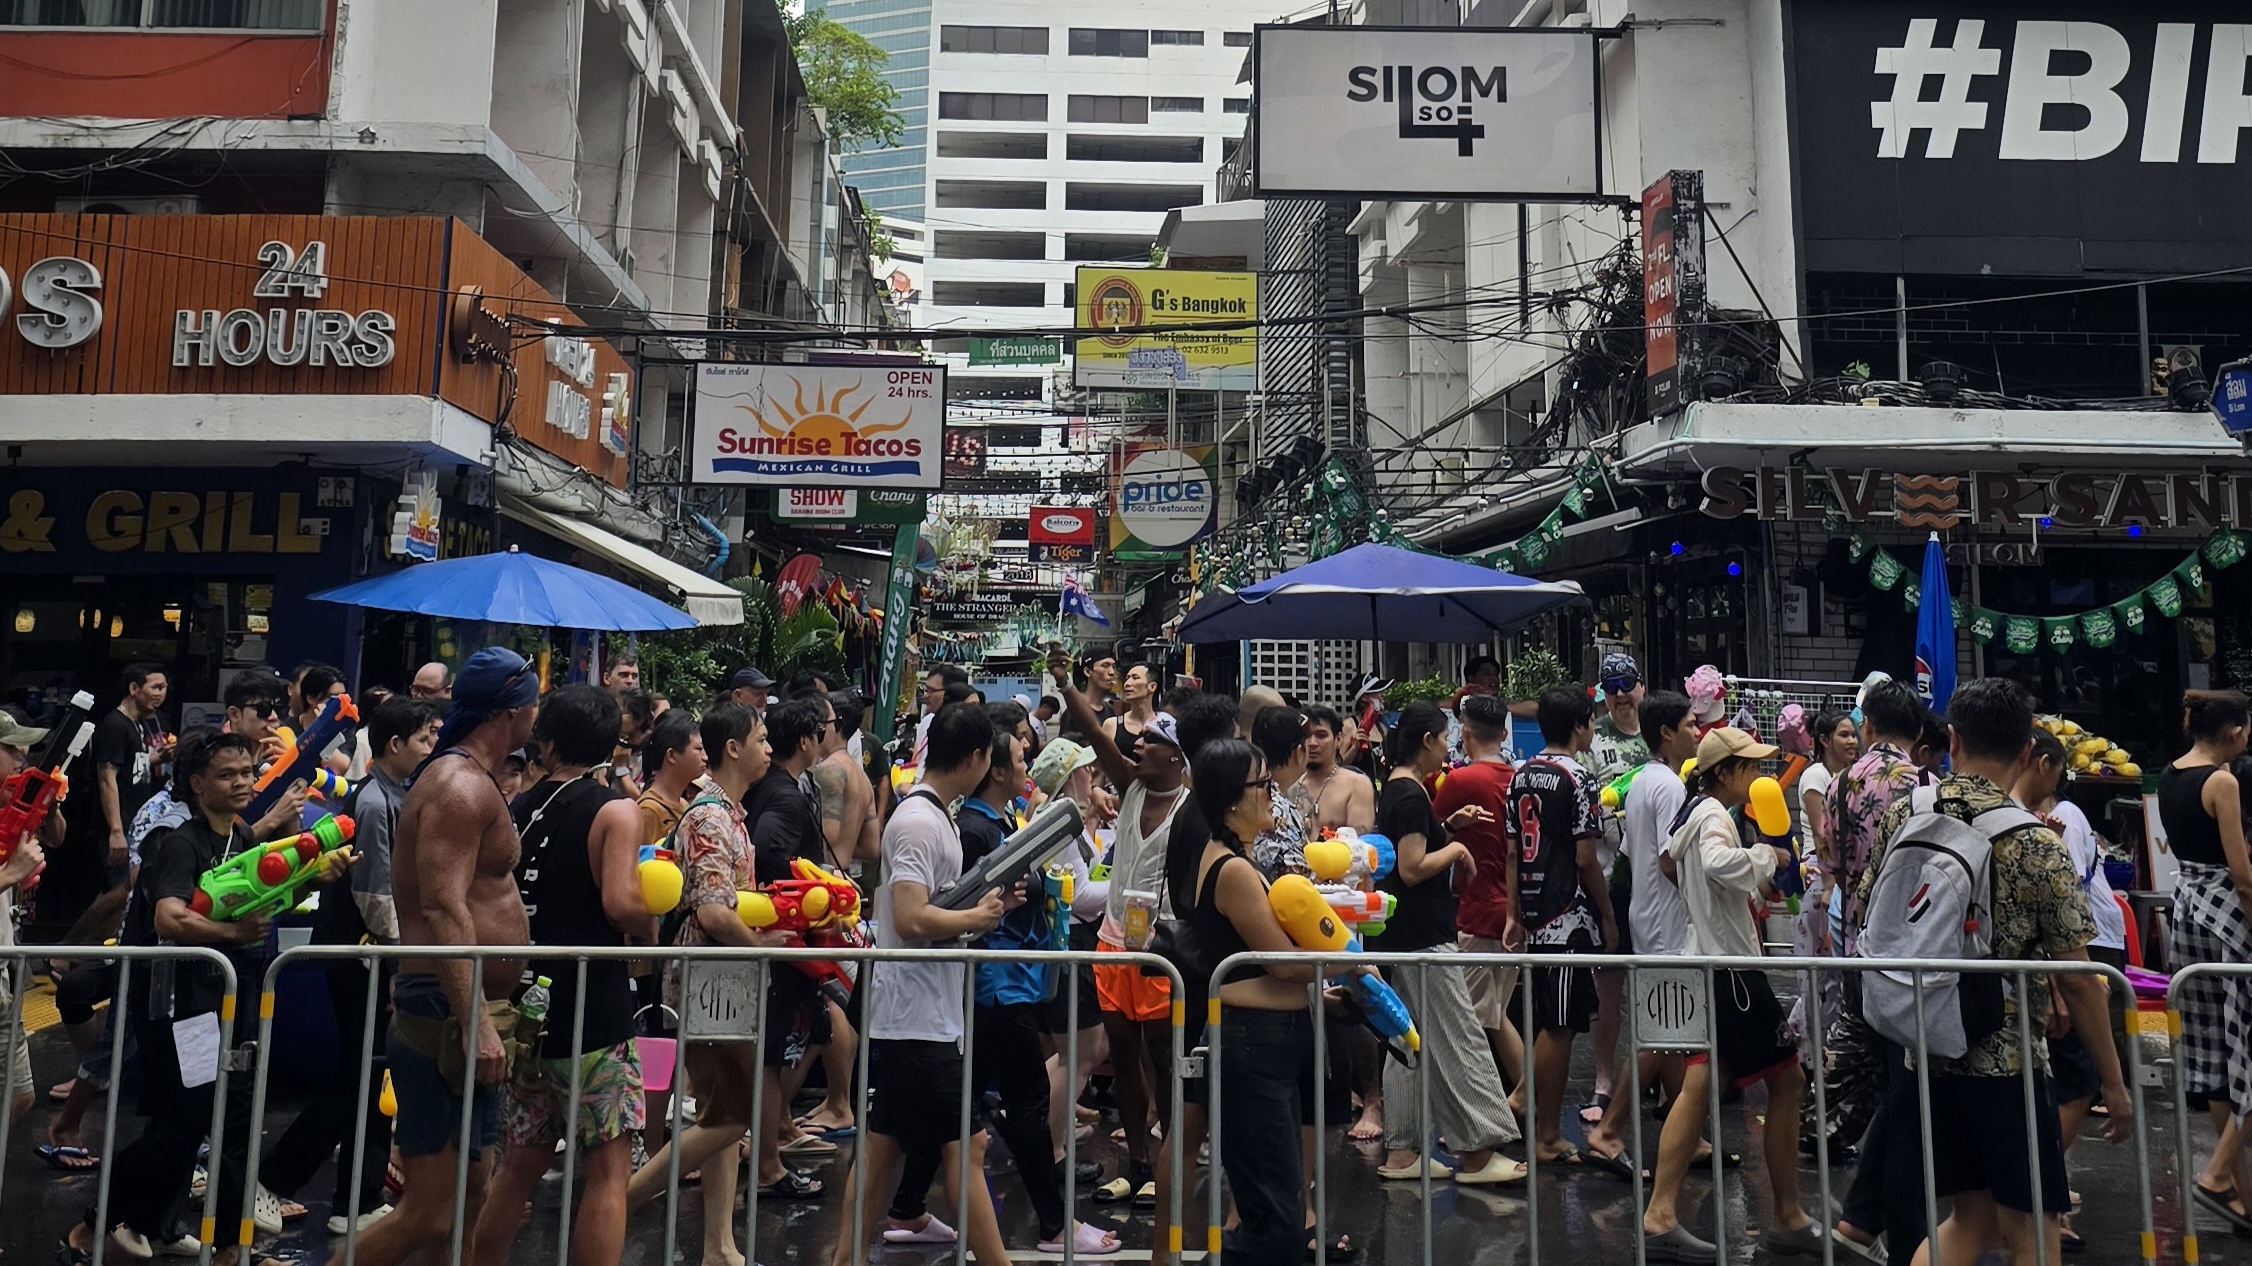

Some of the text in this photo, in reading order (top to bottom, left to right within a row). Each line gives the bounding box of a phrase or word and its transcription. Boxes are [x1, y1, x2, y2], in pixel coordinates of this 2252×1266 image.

[1346, 65, 1508, 104] SILOM
[253, 240, 328, 299] 24
[1648, 274, 1672, 304] OPEN
[0, 255, 104, 349] S
[1151, 289, 1247, 314] G's Bangkok
[1649, 312, 1672, 342] NOW
[172, 308, 396, 368] HOURS
[1181, 346, 1229, 355] 02 632 9513
[887, 371, 933, 385] OPEN
[888, 386, 933, 399] 24 hrs.
[717, 427, 922, 458] Sunrise Tacos
[757, 462, 871, 473] MEXICAN GRILL
[790, 488, 845, 506] SHOW
[1123, 474, 1205, 514] pride
[1131, 504, 1146, 513] bar
[1157, 504, 1205, 513] restaurant
[0, 489, 57, 553] &
[86, 489, 322, 553] GRILL
[1046, 518, 1080, 529] Balcony
[1050, 544, 1083, 562] Tiger
[1004, 569, 1033, 580] 2018
[934, 602, 957, 612] THE
[1970, 624, 1995, 640] Chang
[2050, 634, 2074, 645] Chang
[1602, 748, 1617, 765] 10
[1518, 794, 1543, 863] 8
